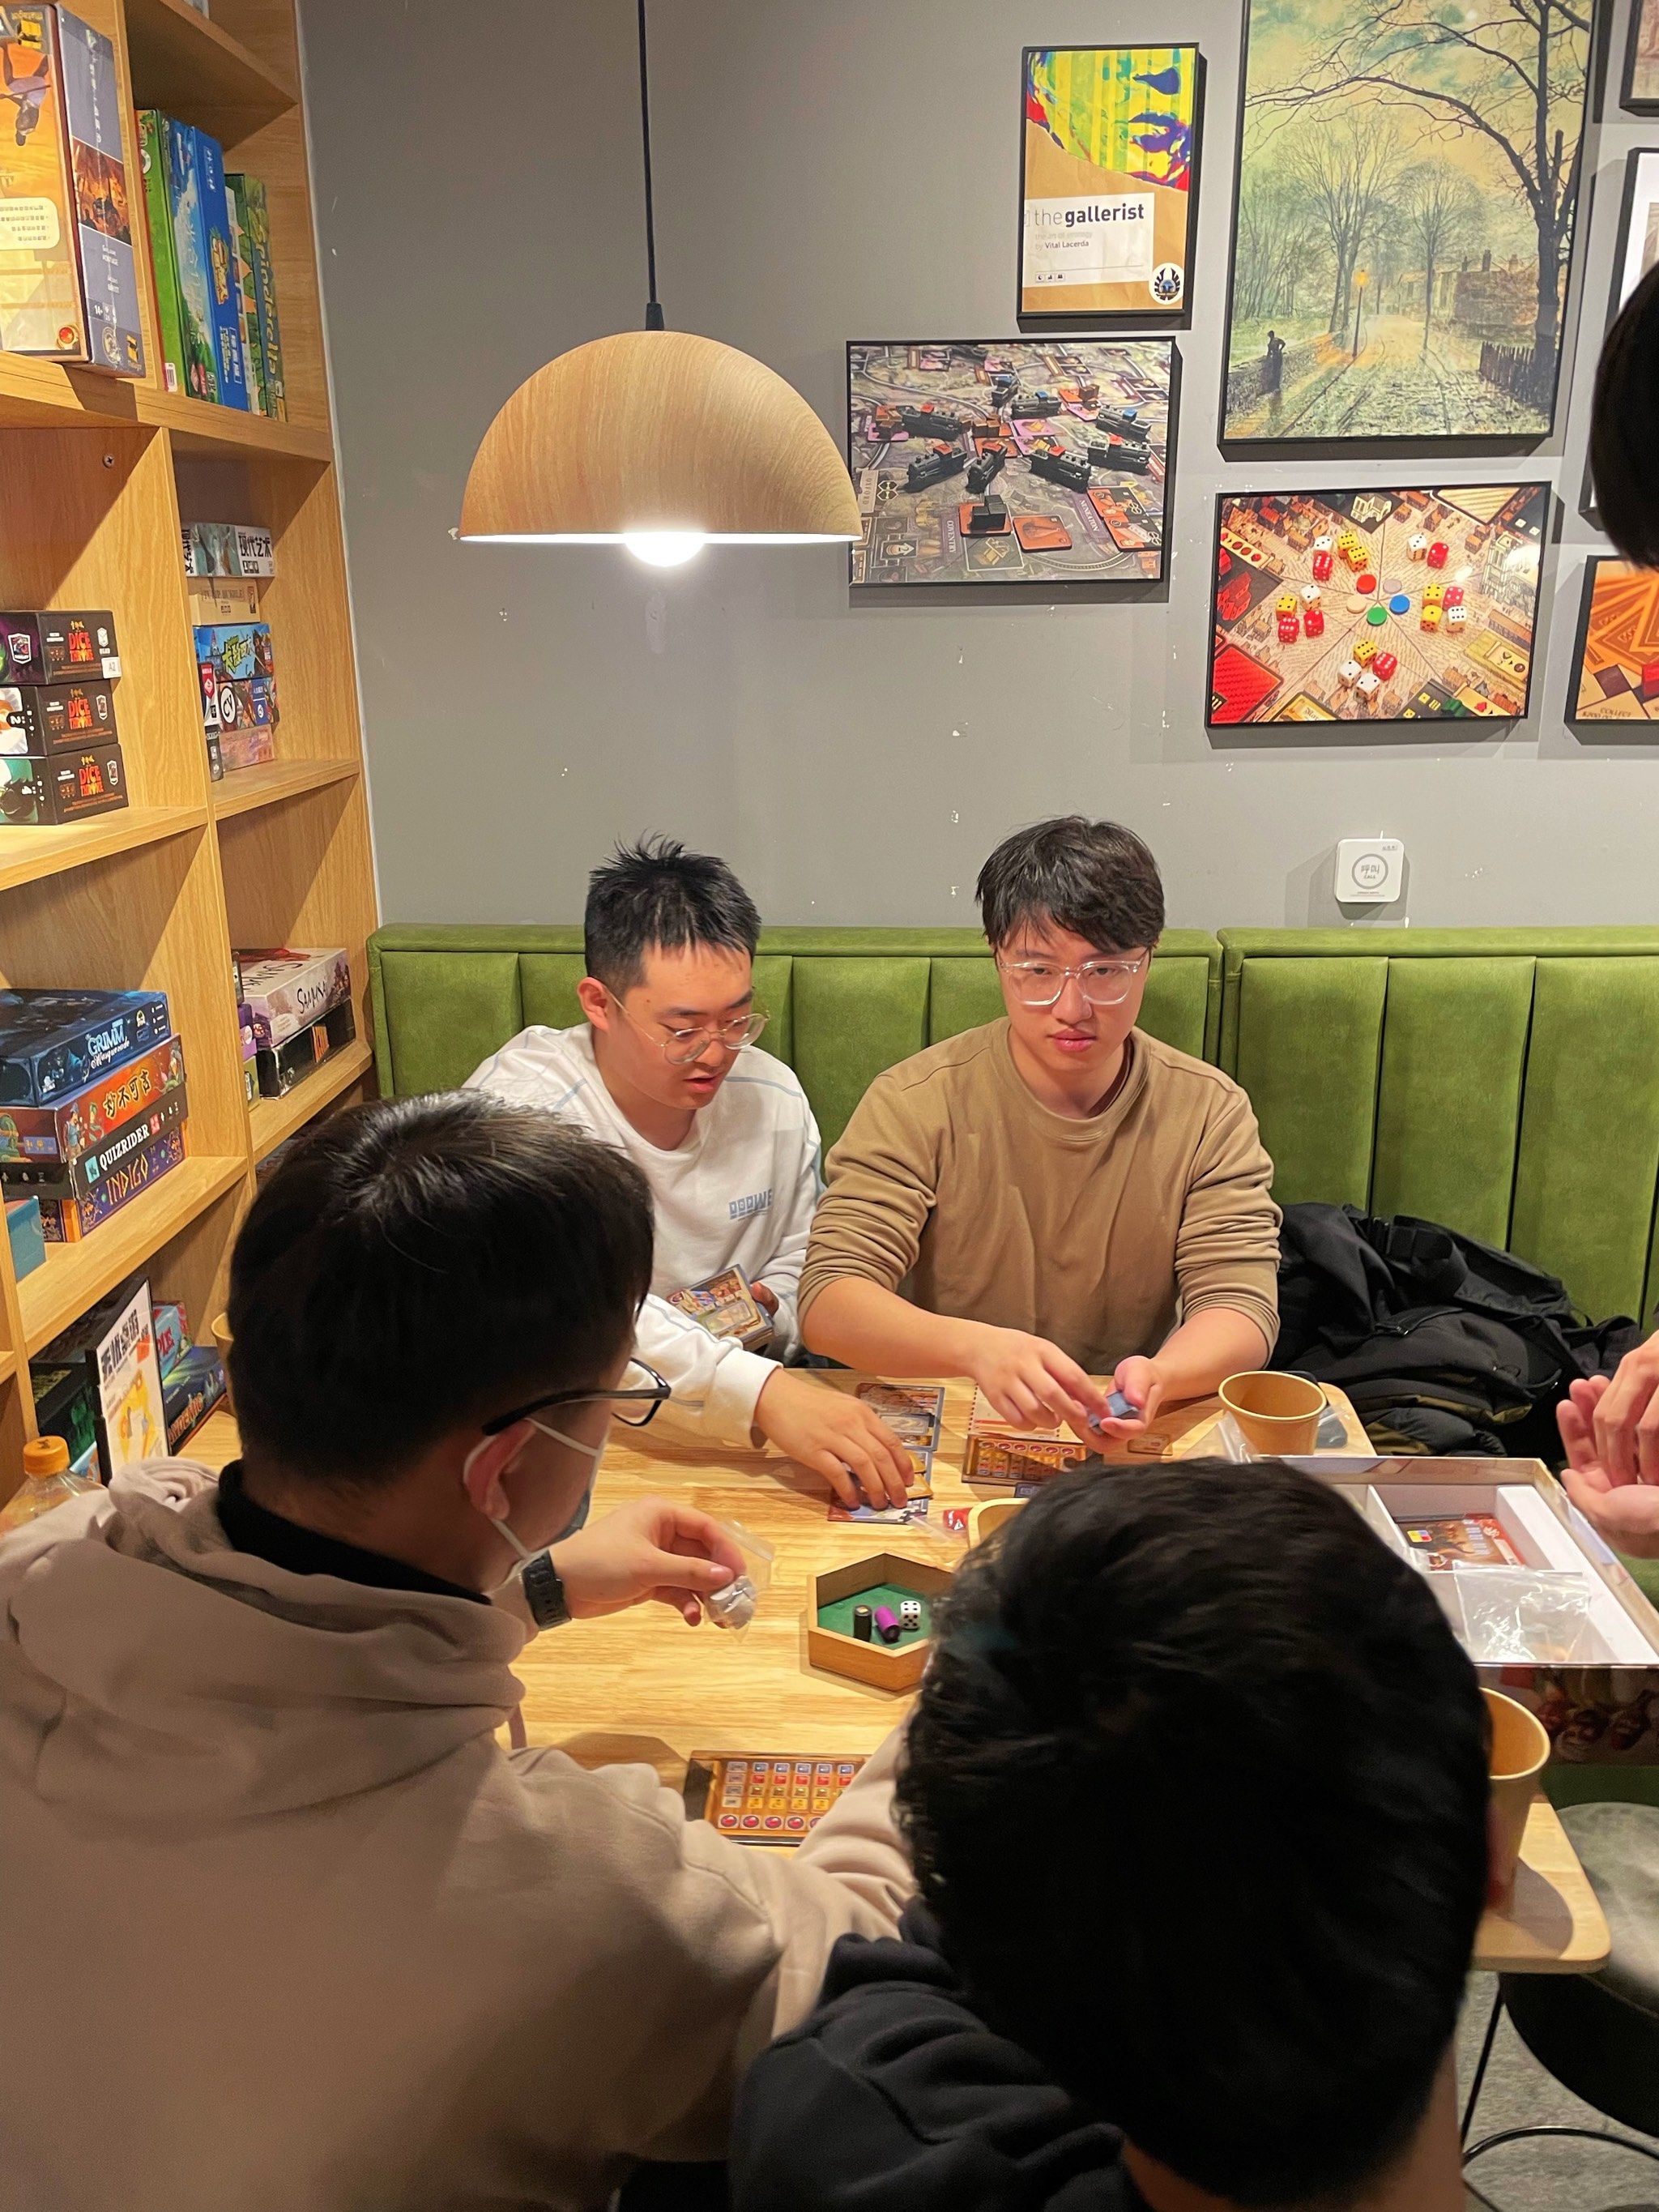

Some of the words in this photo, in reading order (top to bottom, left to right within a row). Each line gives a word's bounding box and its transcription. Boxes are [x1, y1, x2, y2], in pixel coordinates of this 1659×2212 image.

[1065, 203, 1144, 228] gallerist
[1045, 241, 1061, 249] Vital
[1062, 240, 1090, 248] Lacerda
[238, 535, 272, 558] 现代艺术
[946, 520, 956, 553] COVENTRY
[68, 631, 92, 650] DICE
[68, 698, 91, 718] DICE
[223, 694, 233, 718] CV
[79, 764, 101, 785] DICE
[87, 1024, 126, 1057] GRIMM
[90, 1036, 130, 1070] Masquerade
[99, 1124, 150, 1172] QUIZRIDER
[106, 1151, 150, 1206] INDIGO
